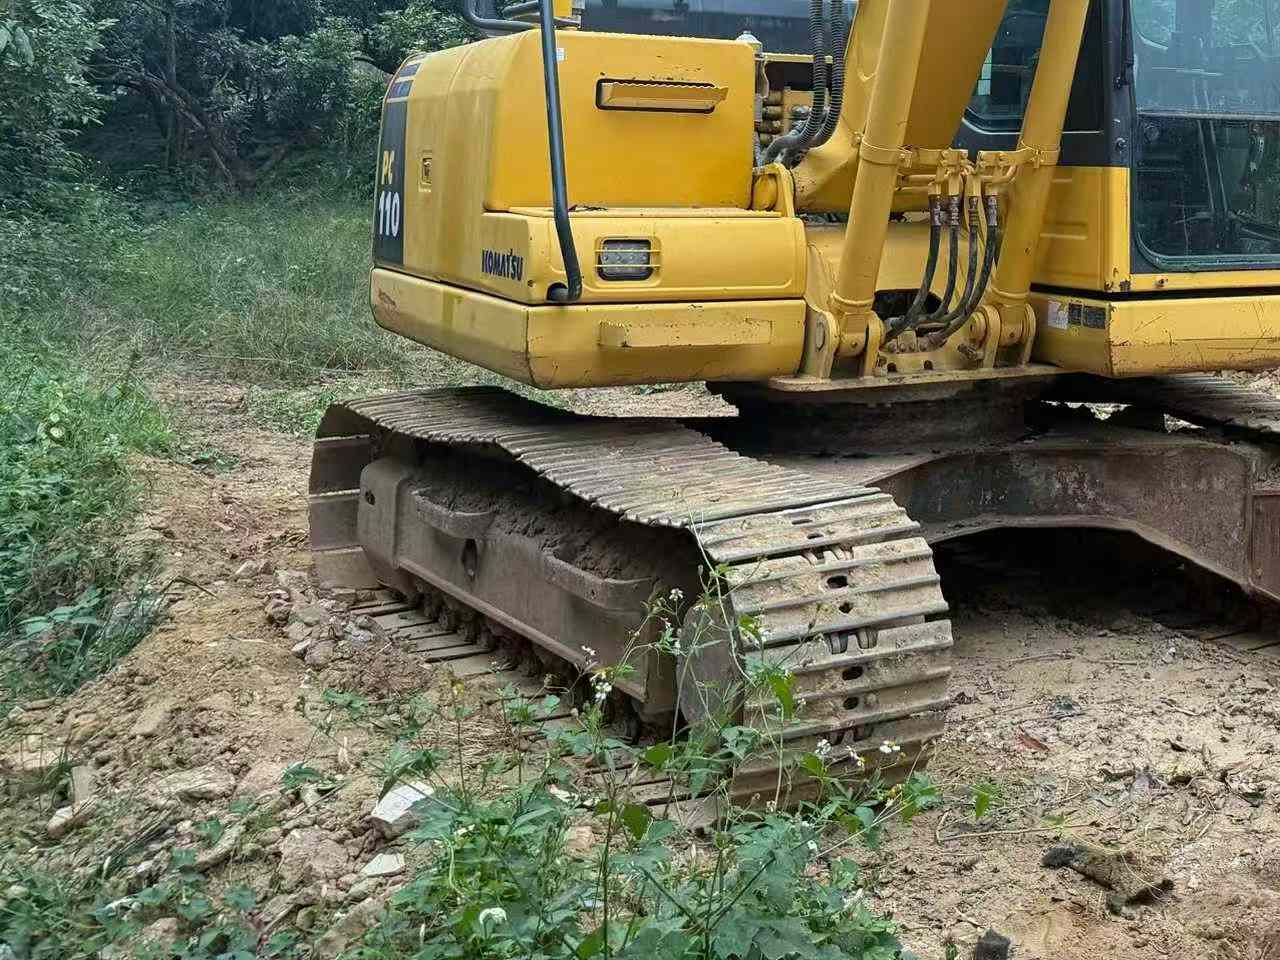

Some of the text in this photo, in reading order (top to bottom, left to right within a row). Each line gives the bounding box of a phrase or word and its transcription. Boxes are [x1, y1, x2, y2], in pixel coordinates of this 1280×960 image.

[381, 150, 395, 185] PC
[379, 191, 400, 237] 110
[481, 248, 524, 282] KOMATSU
